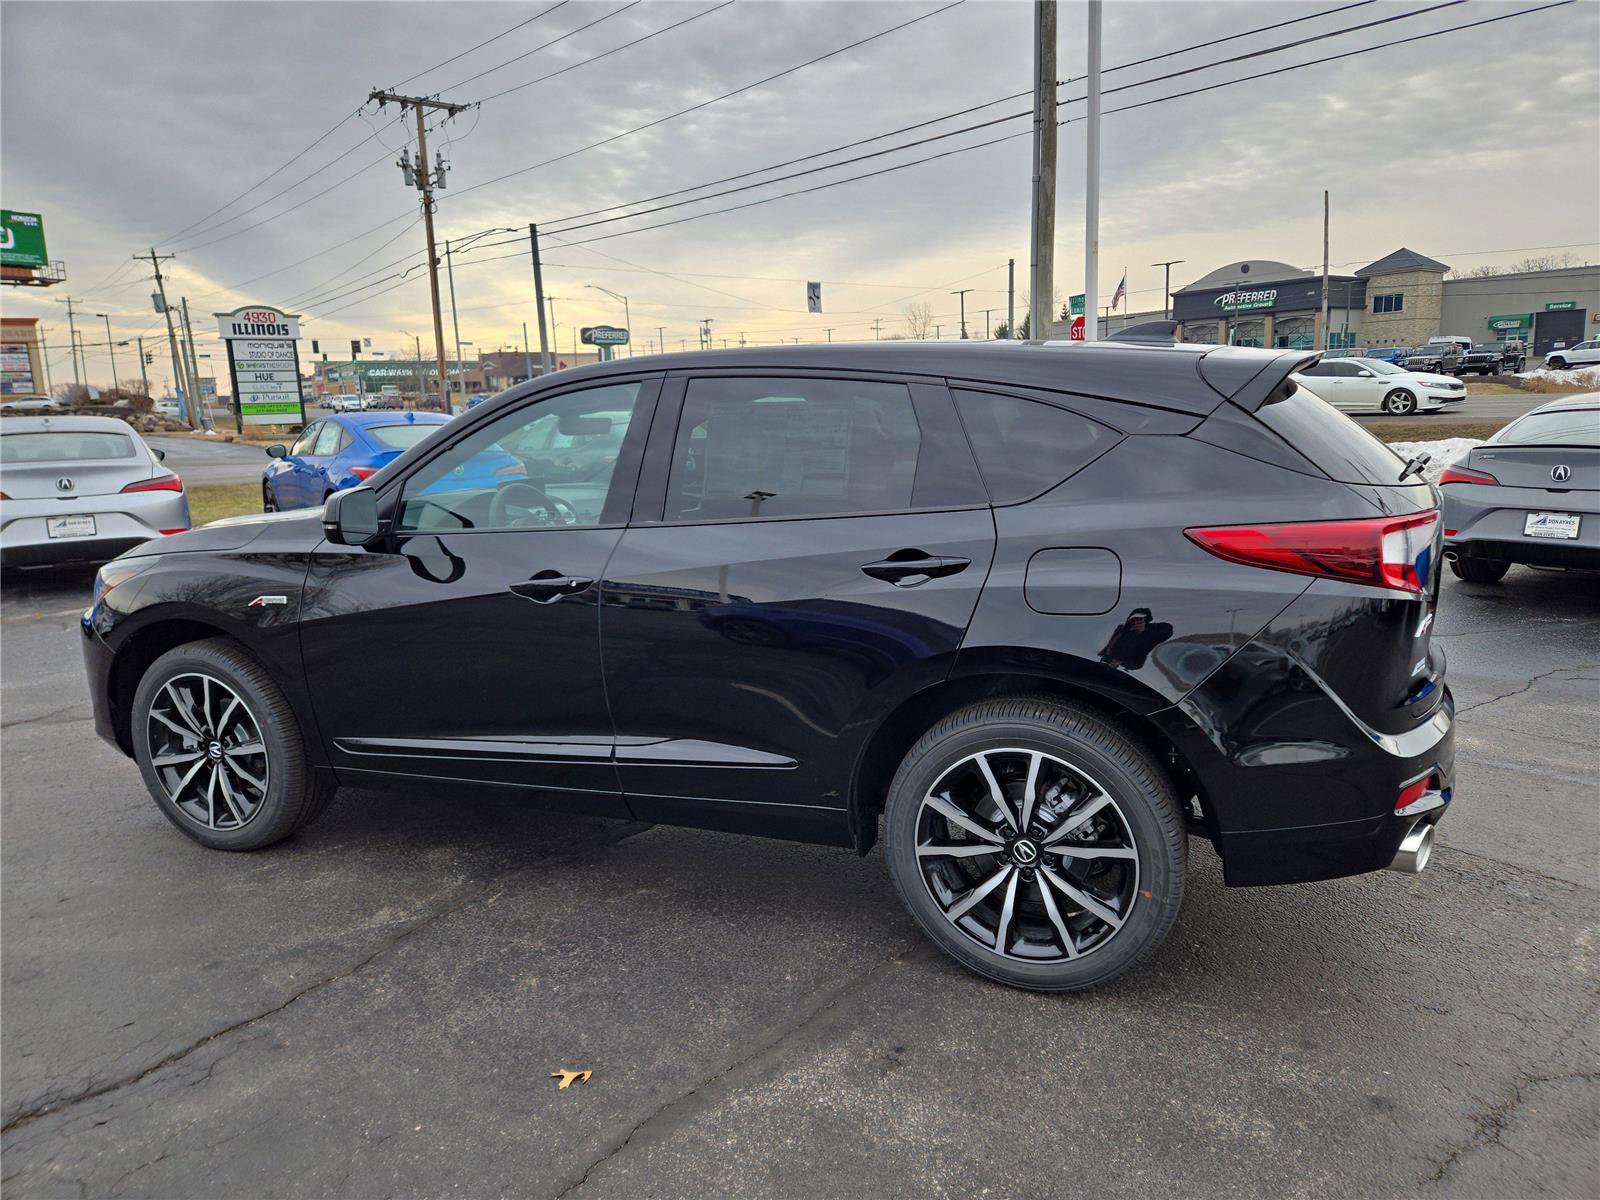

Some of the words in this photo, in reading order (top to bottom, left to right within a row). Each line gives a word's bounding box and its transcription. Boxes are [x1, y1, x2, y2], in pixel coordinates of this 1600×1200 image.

[1221, 290, 1277, 307] PREFERRED
[244, 312, 276, 323] 4930
[232, 323, 289, 335] ILLINOIS
[1072, 326, 1086, 339] STO
[368, 368, 387, 377] CAR
